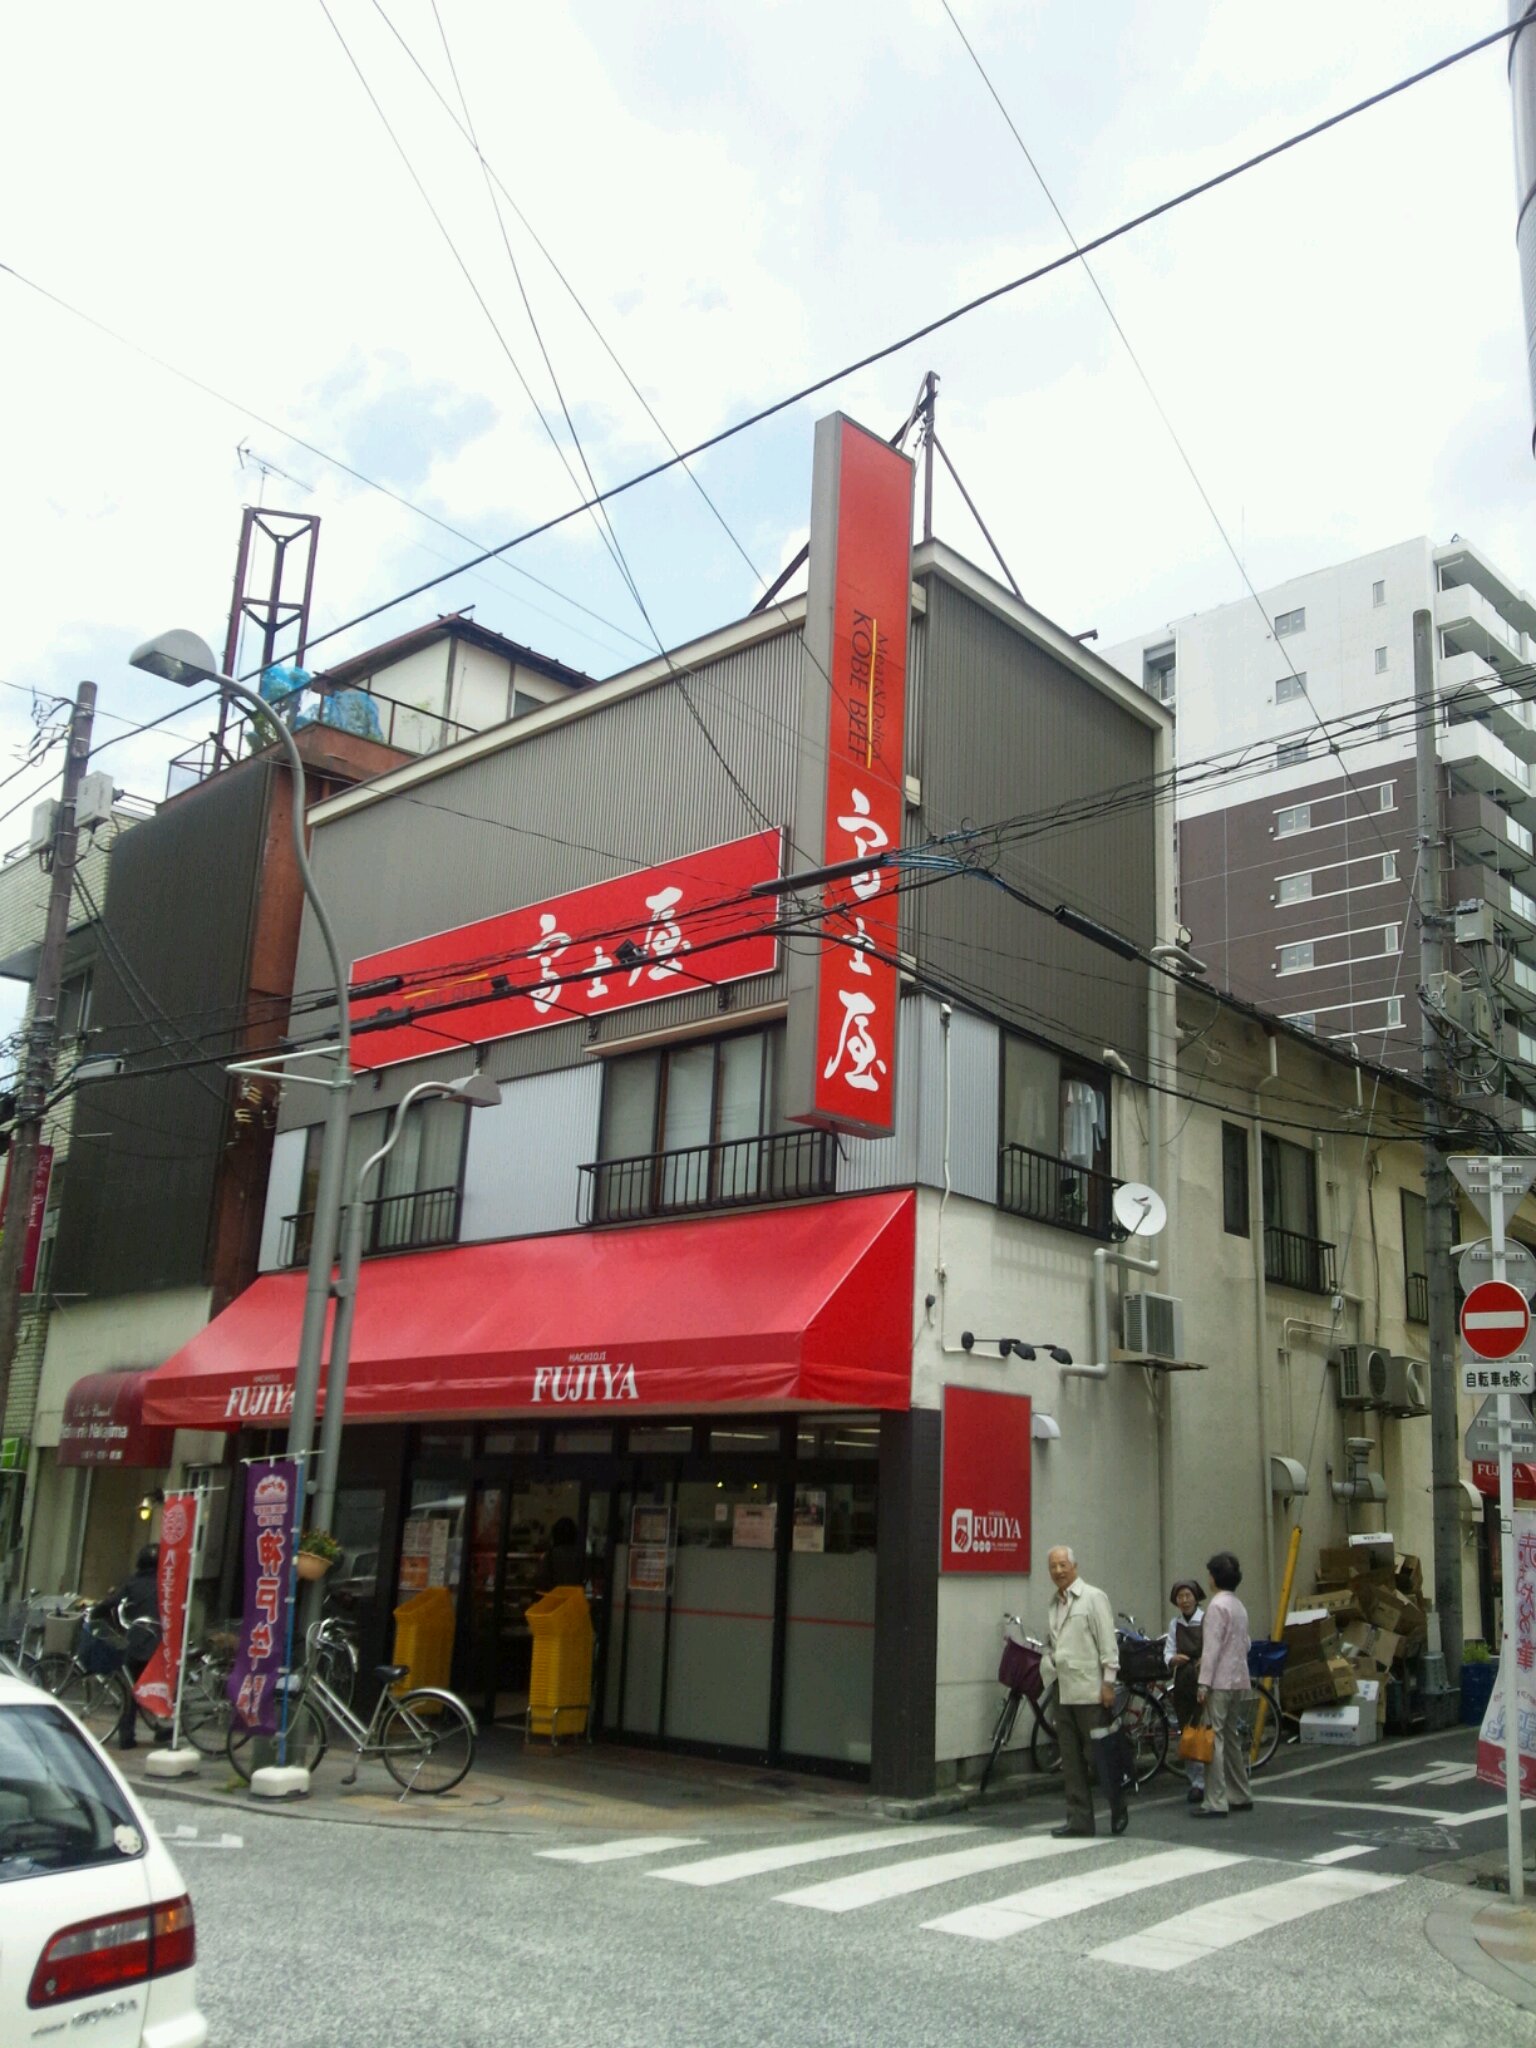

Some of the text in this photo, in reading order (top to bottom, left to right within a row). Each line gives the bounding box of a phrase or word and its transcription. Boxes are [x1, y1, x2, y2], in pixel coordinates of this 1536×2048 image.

[848, 609, 871, 764] KOBE BEEF
[527, 886, 692, 1014] 富士屋
[823, 788, 889, 1092] 富士屋
[530, 1363, 639, 1402] FUJIYA
[1466, 1370, 1530, 1388] 自転車を除く
[974, 1516, 1021, 1539] FUJIYA
